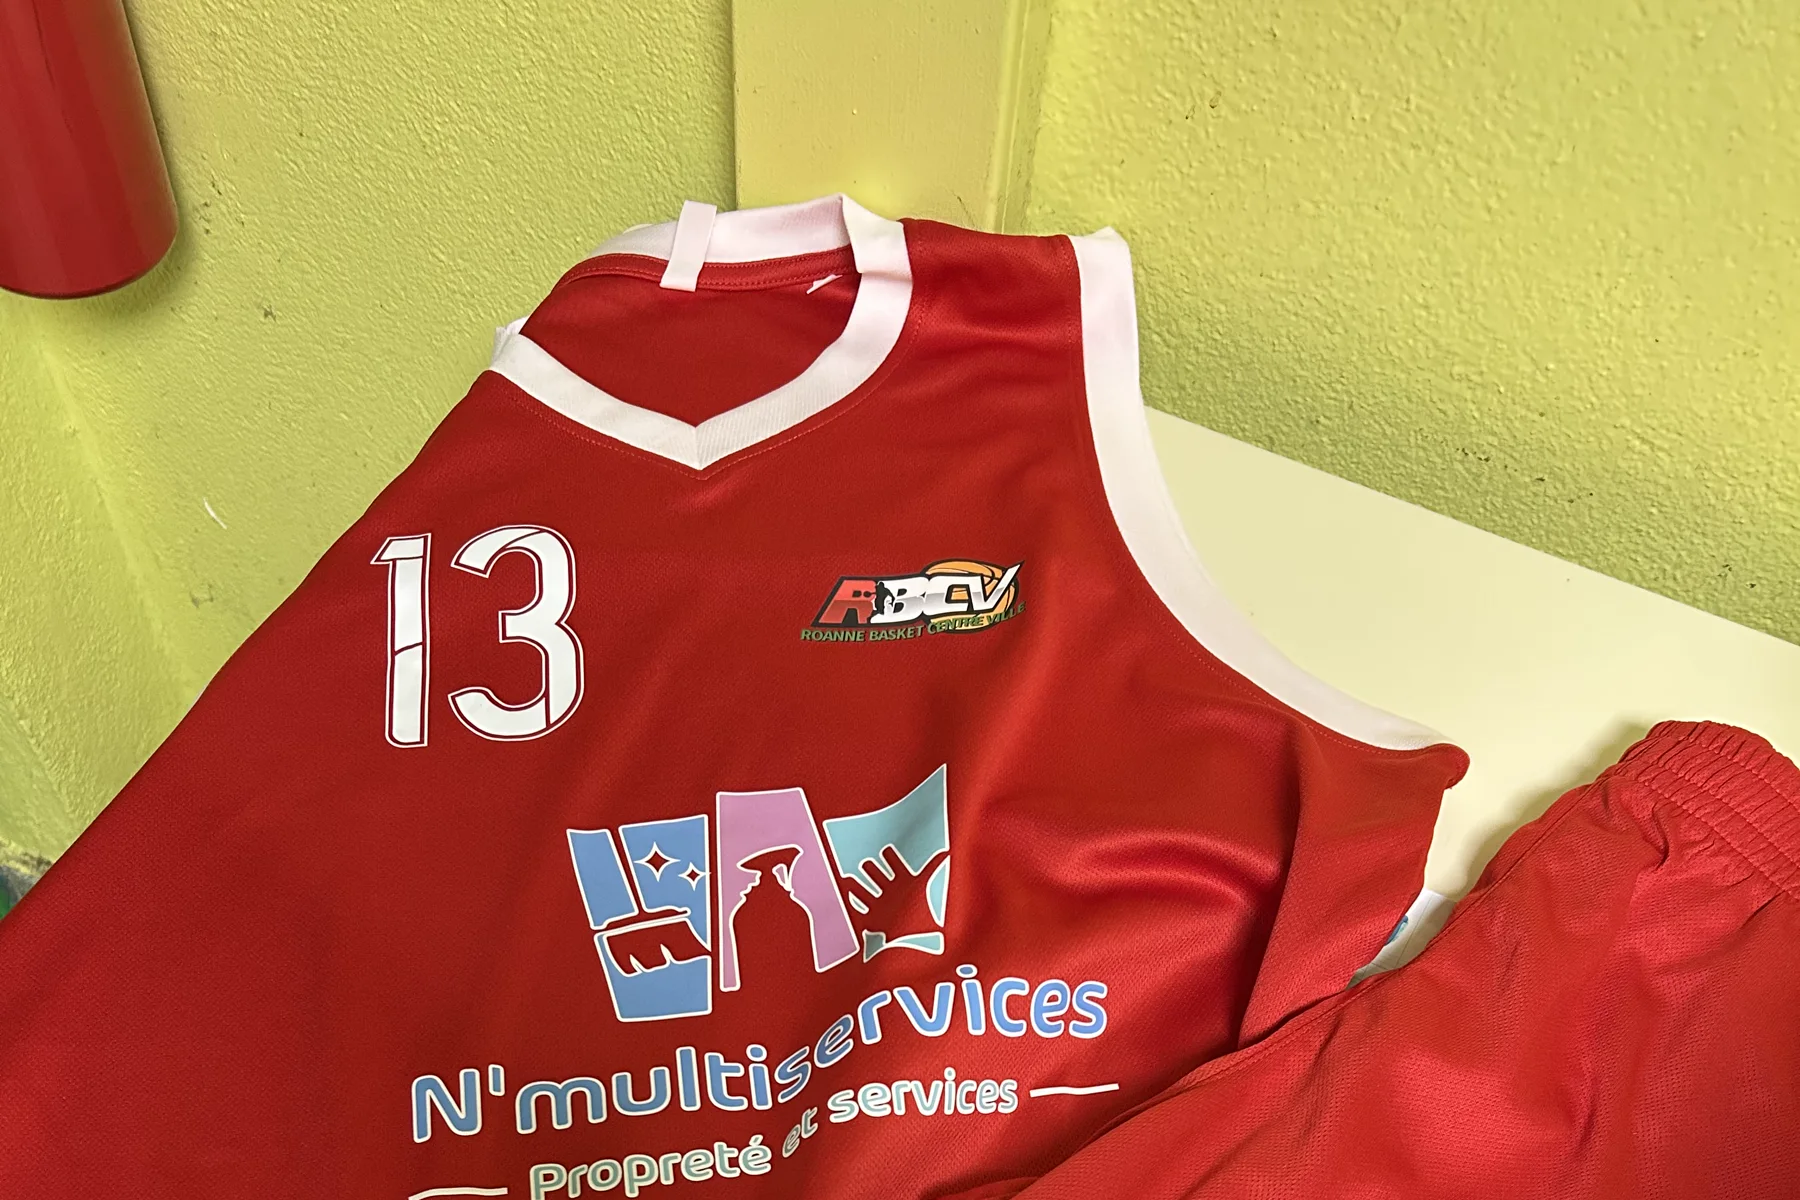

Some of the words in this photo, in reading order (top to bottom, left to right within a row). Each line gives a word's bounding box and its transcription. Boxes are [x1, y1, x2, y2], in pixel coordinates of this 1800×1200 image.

[370, 524, 584, 748] 13
[800, 628, 866, 643] ROANNE
[869, 623, 925, 642] BASKET
[986, 601, 1027, 625] VILLE
[815, 561, 1024, 626] RBCV
[411, 964, 1109, 1144] N'multiservices
[781, 1105, 819, 1160] et
[826, 1065, 1020, 1125] services
